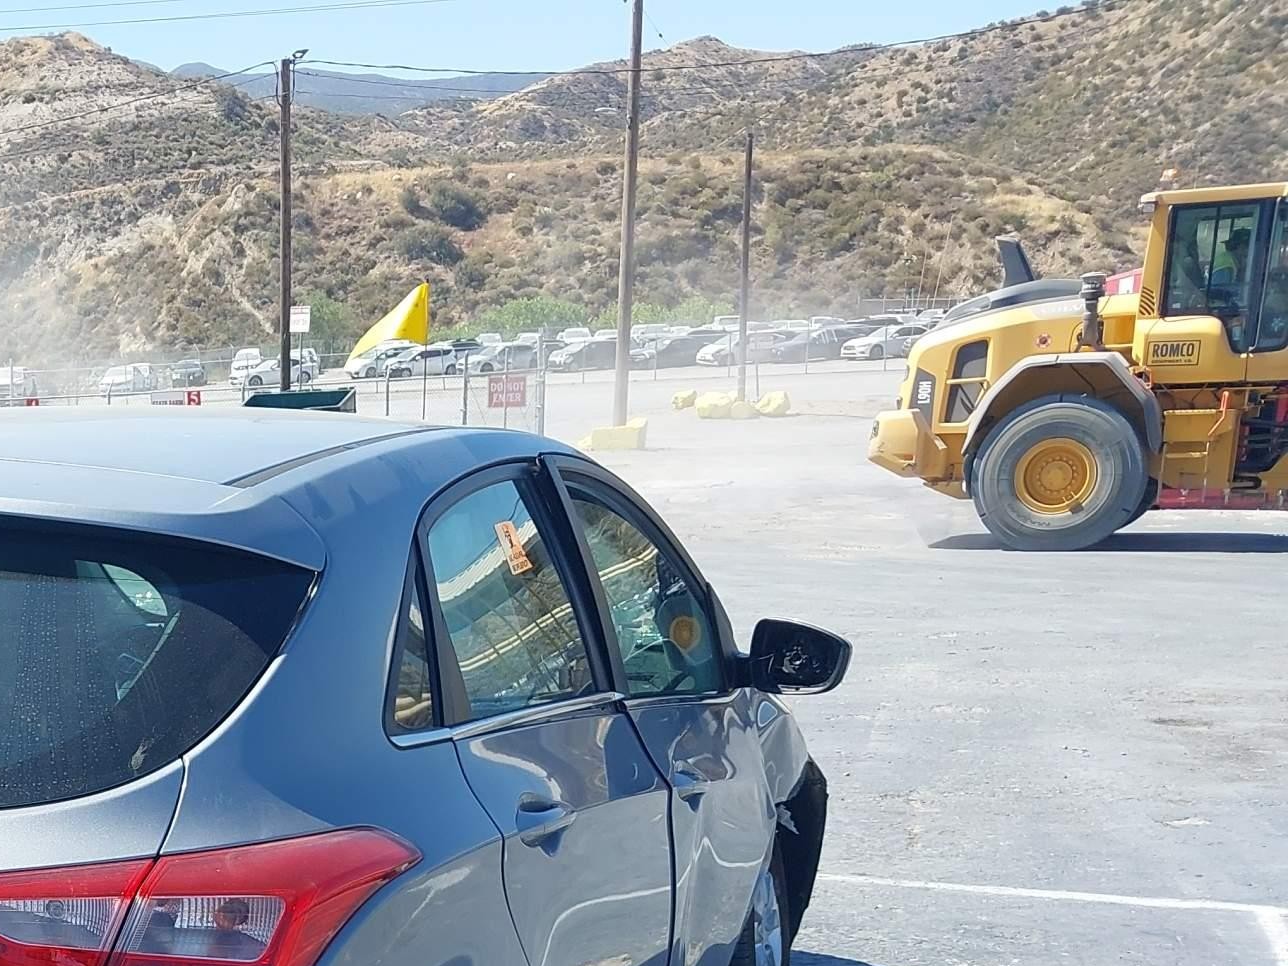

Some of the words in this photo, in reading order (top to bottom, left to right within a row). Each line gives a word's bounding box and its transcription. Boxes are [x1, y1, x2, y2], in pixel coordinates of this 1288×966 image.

[1152, 342, 1195, 358] ROMCO
[490, 382, 504, 392] DO
[506, 381, 524, 391] NOT
[190, 391, 199, 405] 5
[492, 392, 521, 402] ENTER
